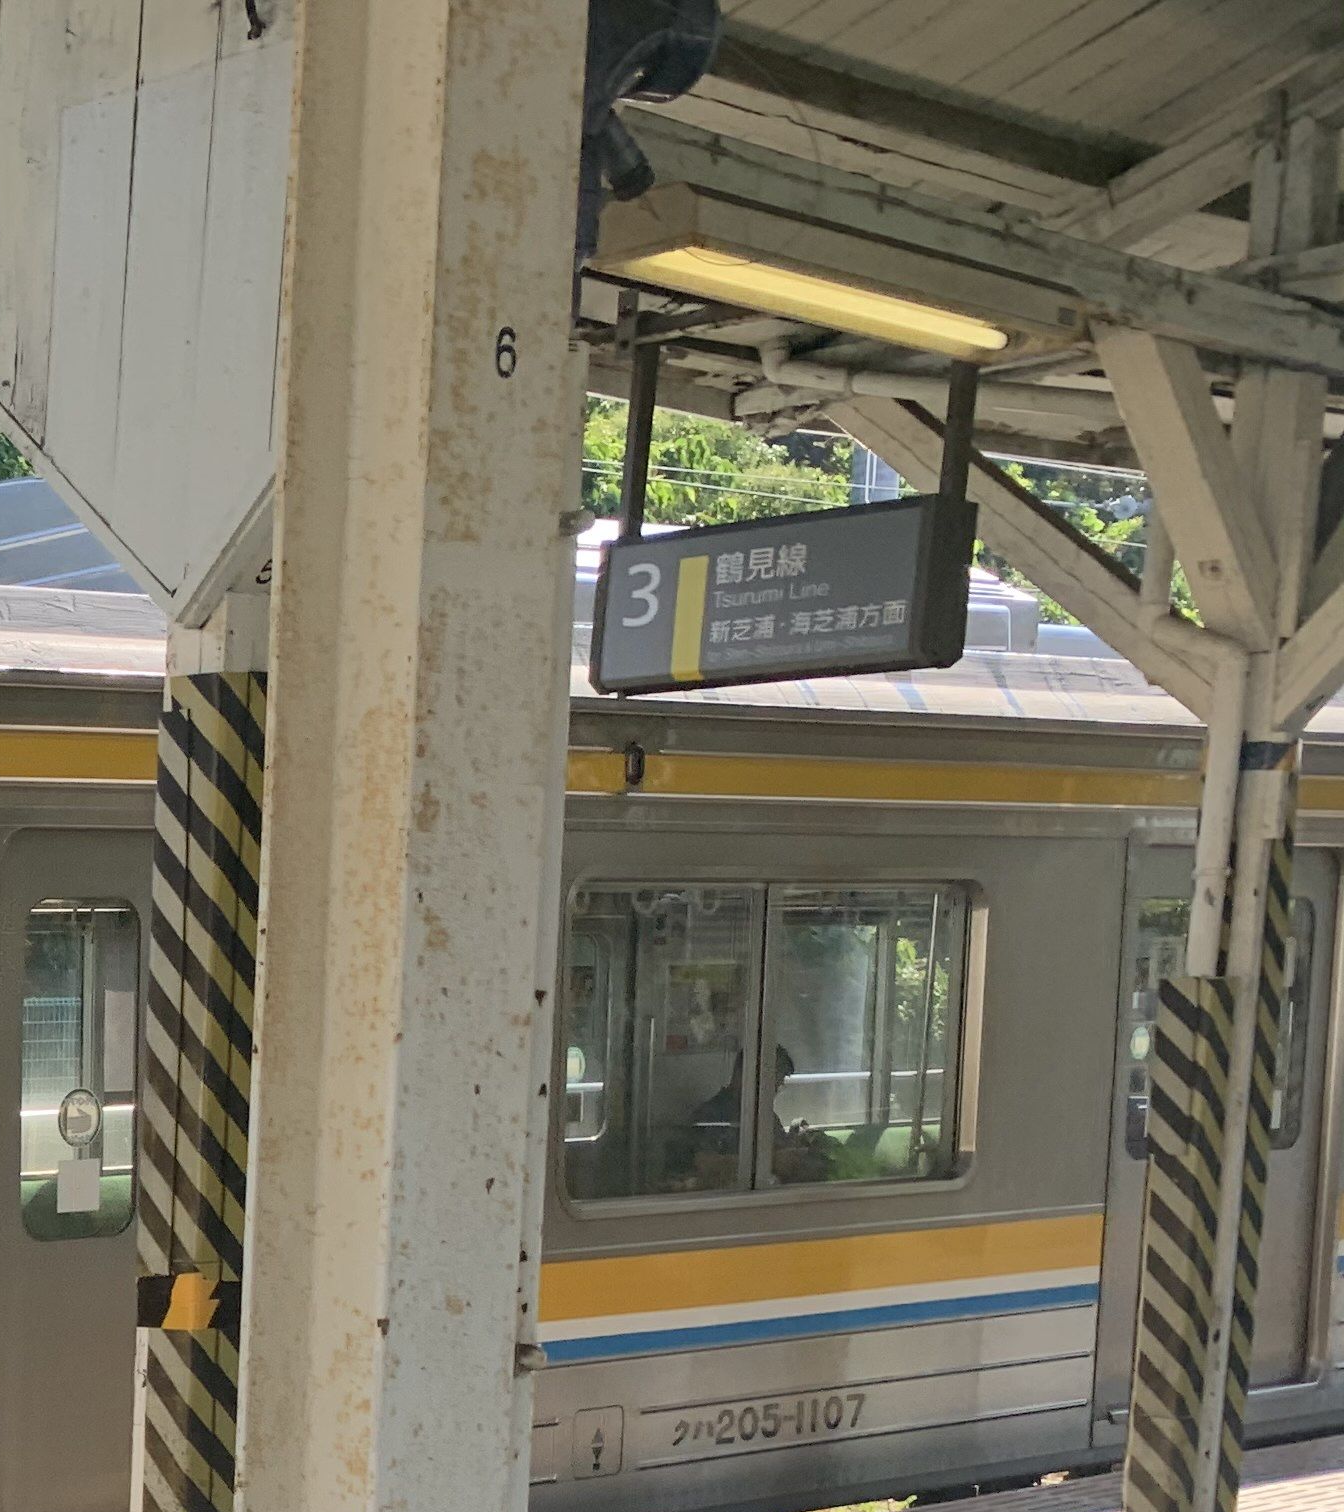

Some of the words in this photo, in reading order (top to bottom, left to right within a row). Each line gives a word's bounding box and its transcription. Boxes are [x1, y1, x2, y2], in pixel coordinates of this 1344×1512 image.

[496, 326, 517, 379] 6
[715, 542, 808, 586] 鶴見線
[621, 563, 662, 628] 3
[713, 586, 783, 609] Tsurumi
[789, 580, 831, 601] Line
